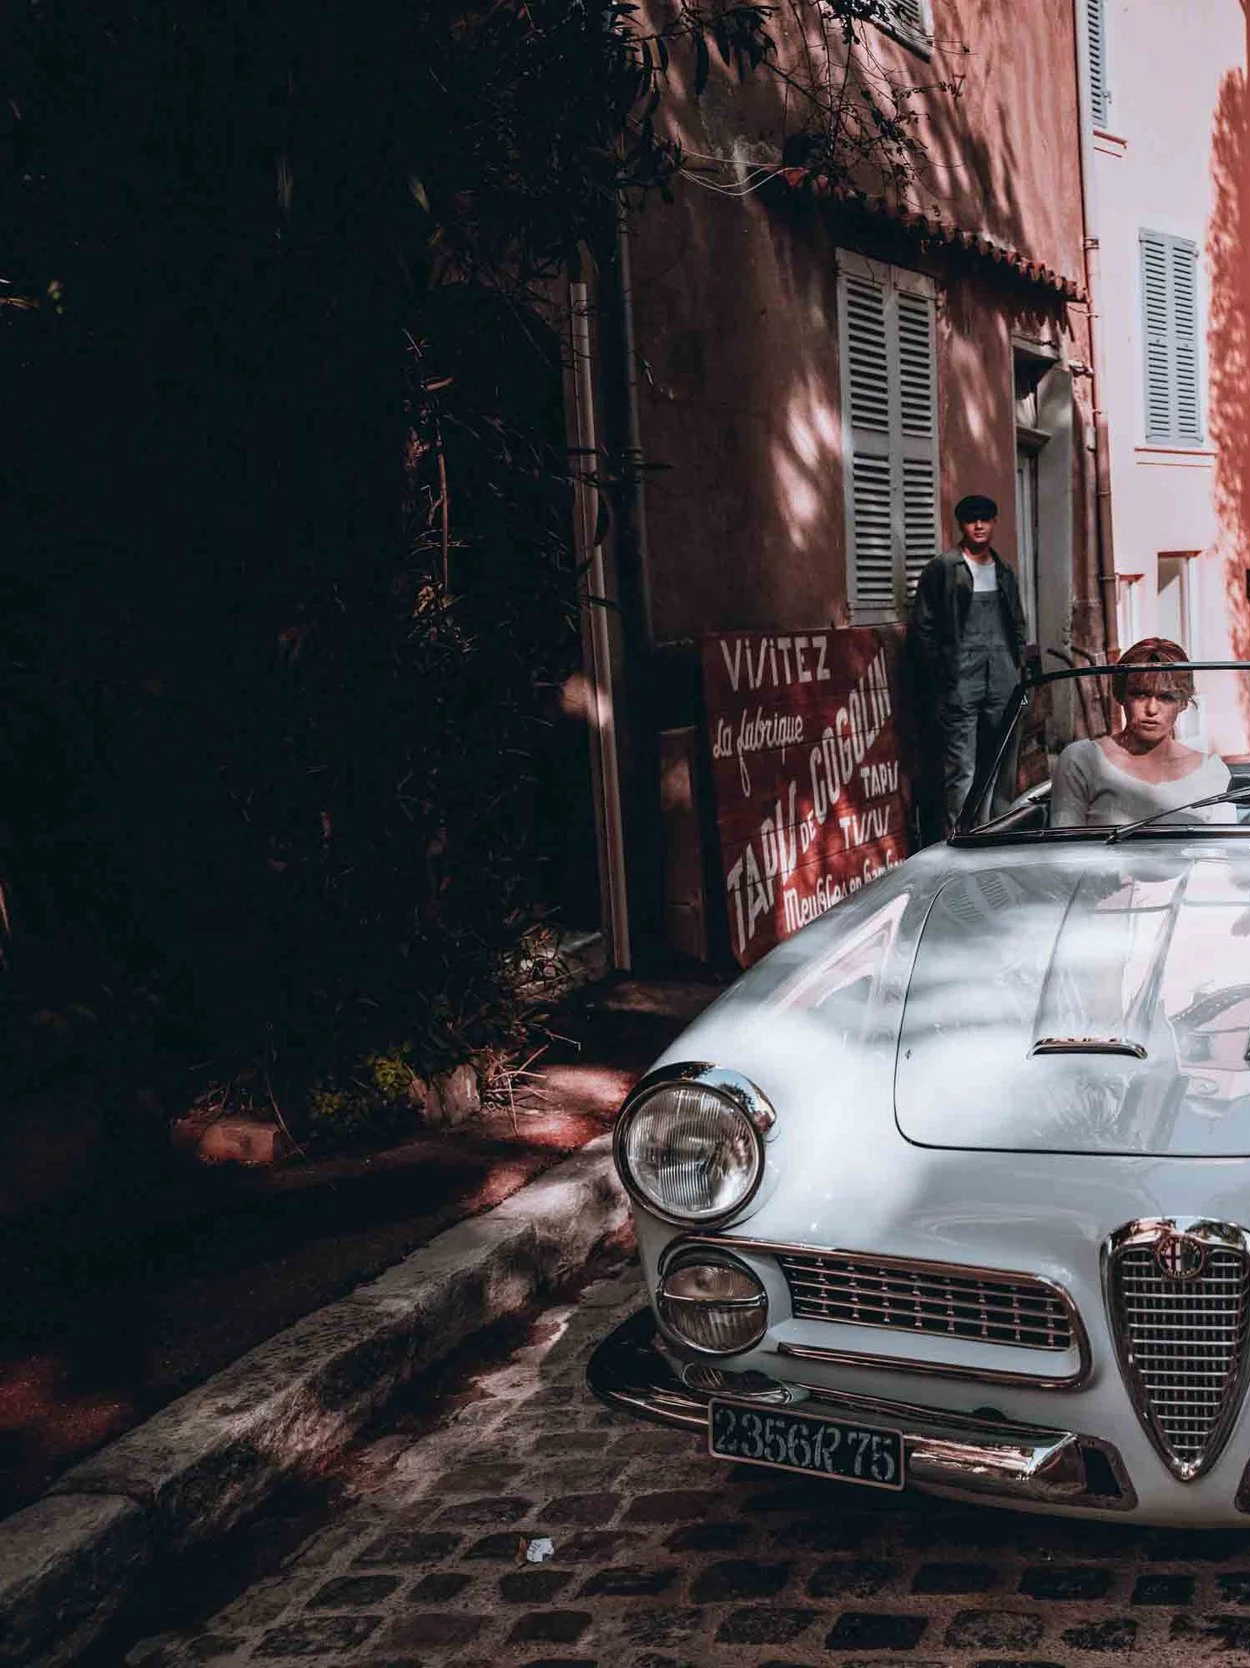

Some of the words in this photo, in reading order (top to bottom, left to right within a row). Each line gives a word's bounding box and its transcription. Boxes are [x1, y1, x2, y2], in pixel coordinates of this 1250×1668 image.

[736, 706, 804, 797] fabrique
[727, 780, 798, 954] TAPIS
[800, 810, 817, 854] DE
[809, 646, 892, 825] COGOLIN
[847, 1431, 896, 1482] 75
